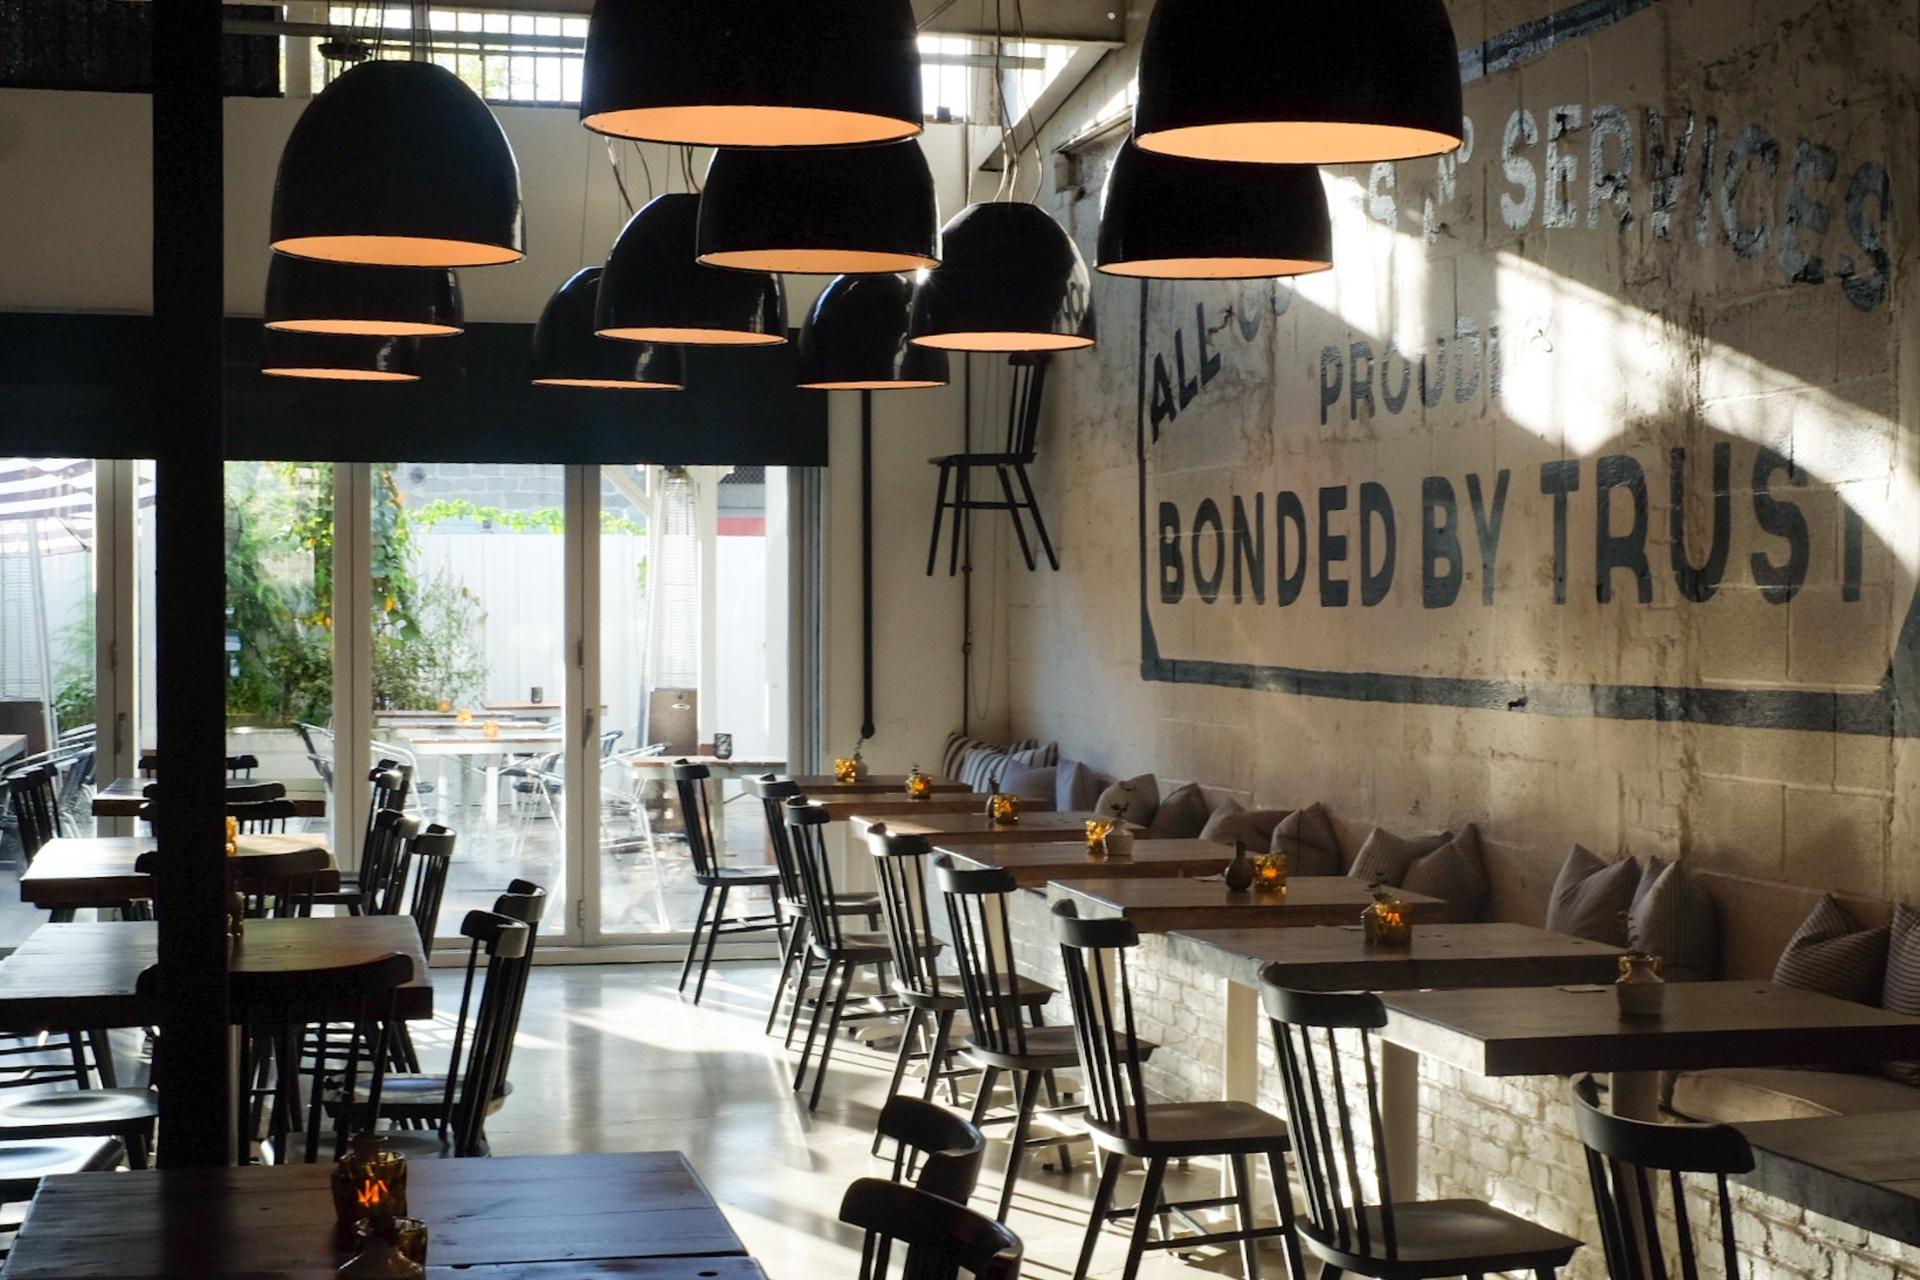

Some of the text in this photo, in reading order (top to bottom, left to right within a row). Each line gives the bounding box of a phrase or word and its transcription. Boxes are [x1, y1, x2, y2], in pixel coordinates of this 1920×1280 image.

[1151, 302, 1221, 445] ALL
[1501, 103, 1893, 313] SERVICES
[1158, 481, 1396, 608] BONDED
[1421, 468, 1511, 609] BY
